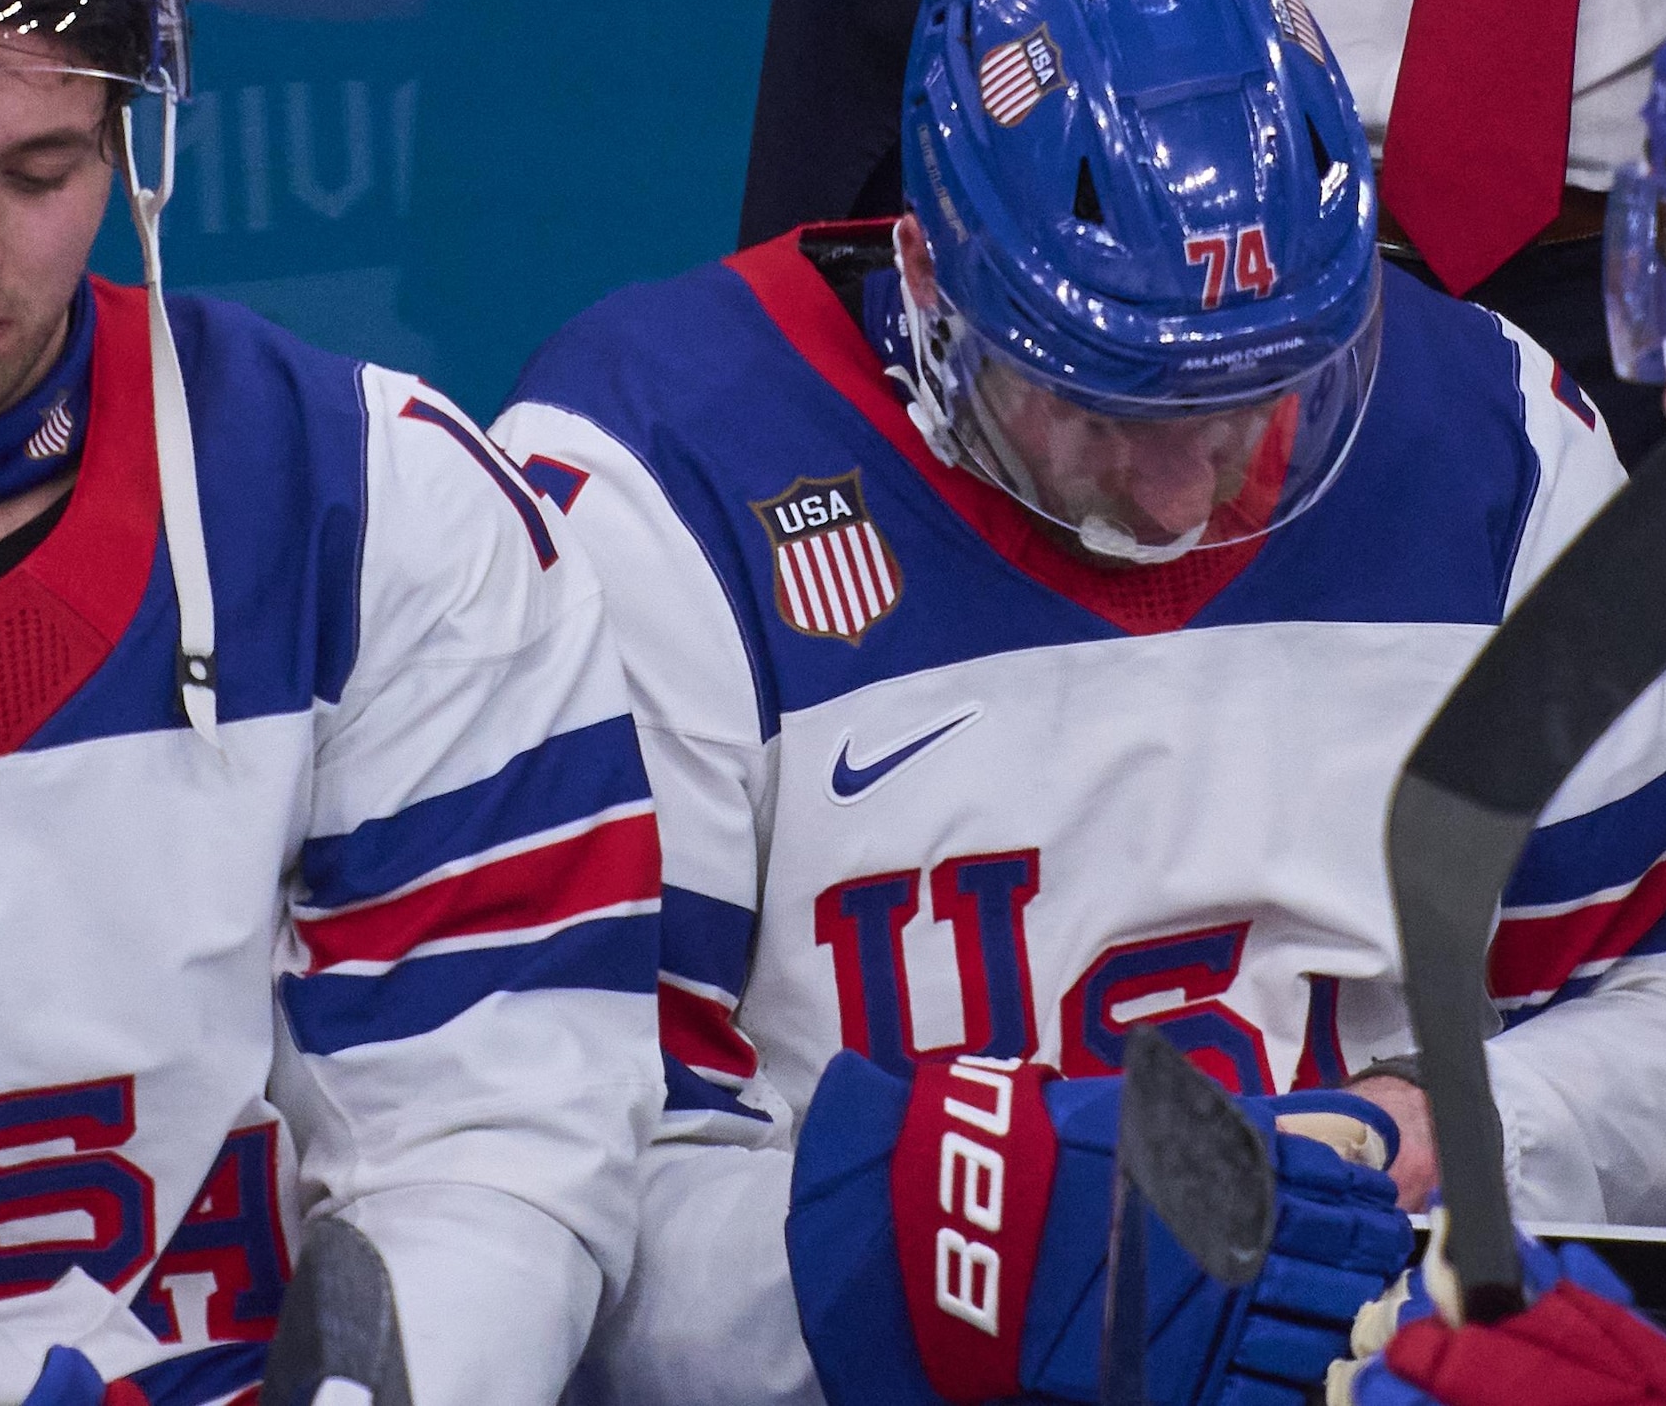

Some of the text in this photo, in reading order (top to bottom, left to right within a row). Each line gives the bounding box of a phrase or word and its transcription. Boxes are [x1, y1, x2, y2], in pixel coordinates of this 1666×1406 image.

[1027, 37, 1056, 86] USA
[1183, 222, 1279, 311] 74
[775, 489, 853, 535] USA
[814, 847, 1351, 1094] US
